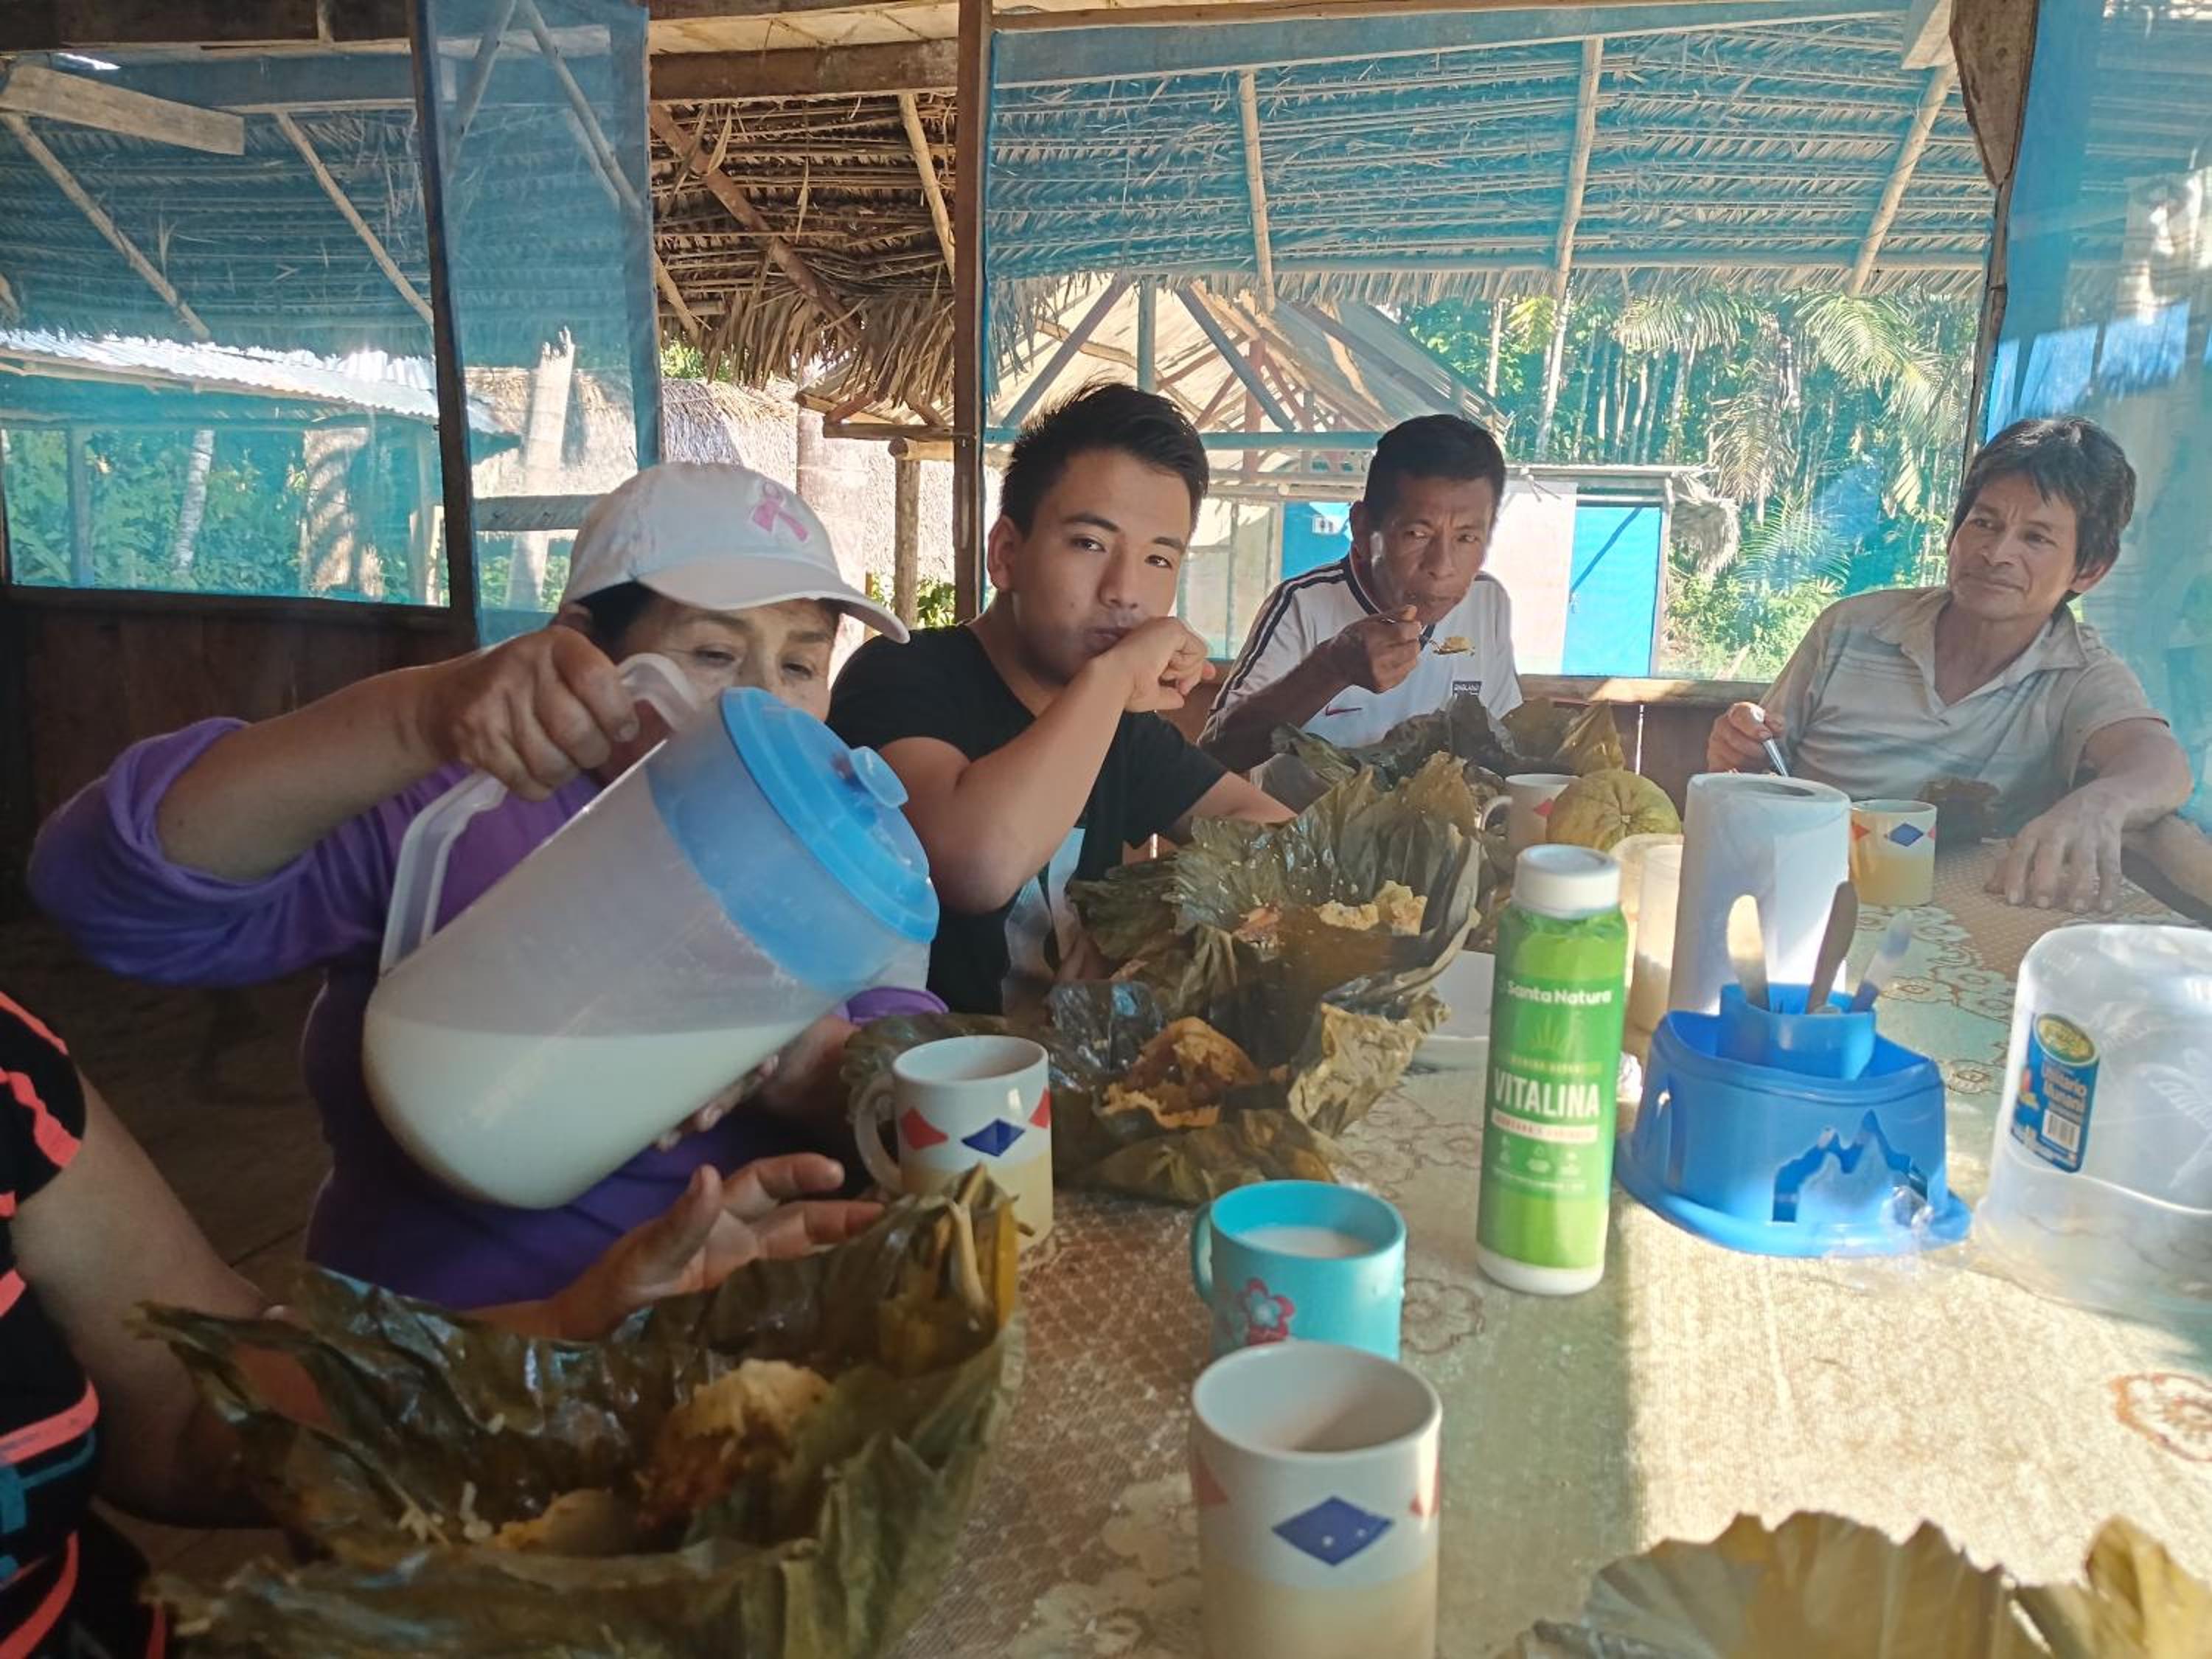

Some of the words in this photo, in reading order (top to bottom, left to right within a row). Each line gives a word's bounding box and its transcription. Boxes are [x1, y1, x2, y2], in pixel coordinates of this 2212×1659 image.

[1508, 980, 1551, 1003] Santa
[1554, 989, 1613, 1005] Natura
[1495, 1068, 1599, 1117] VITALINA
